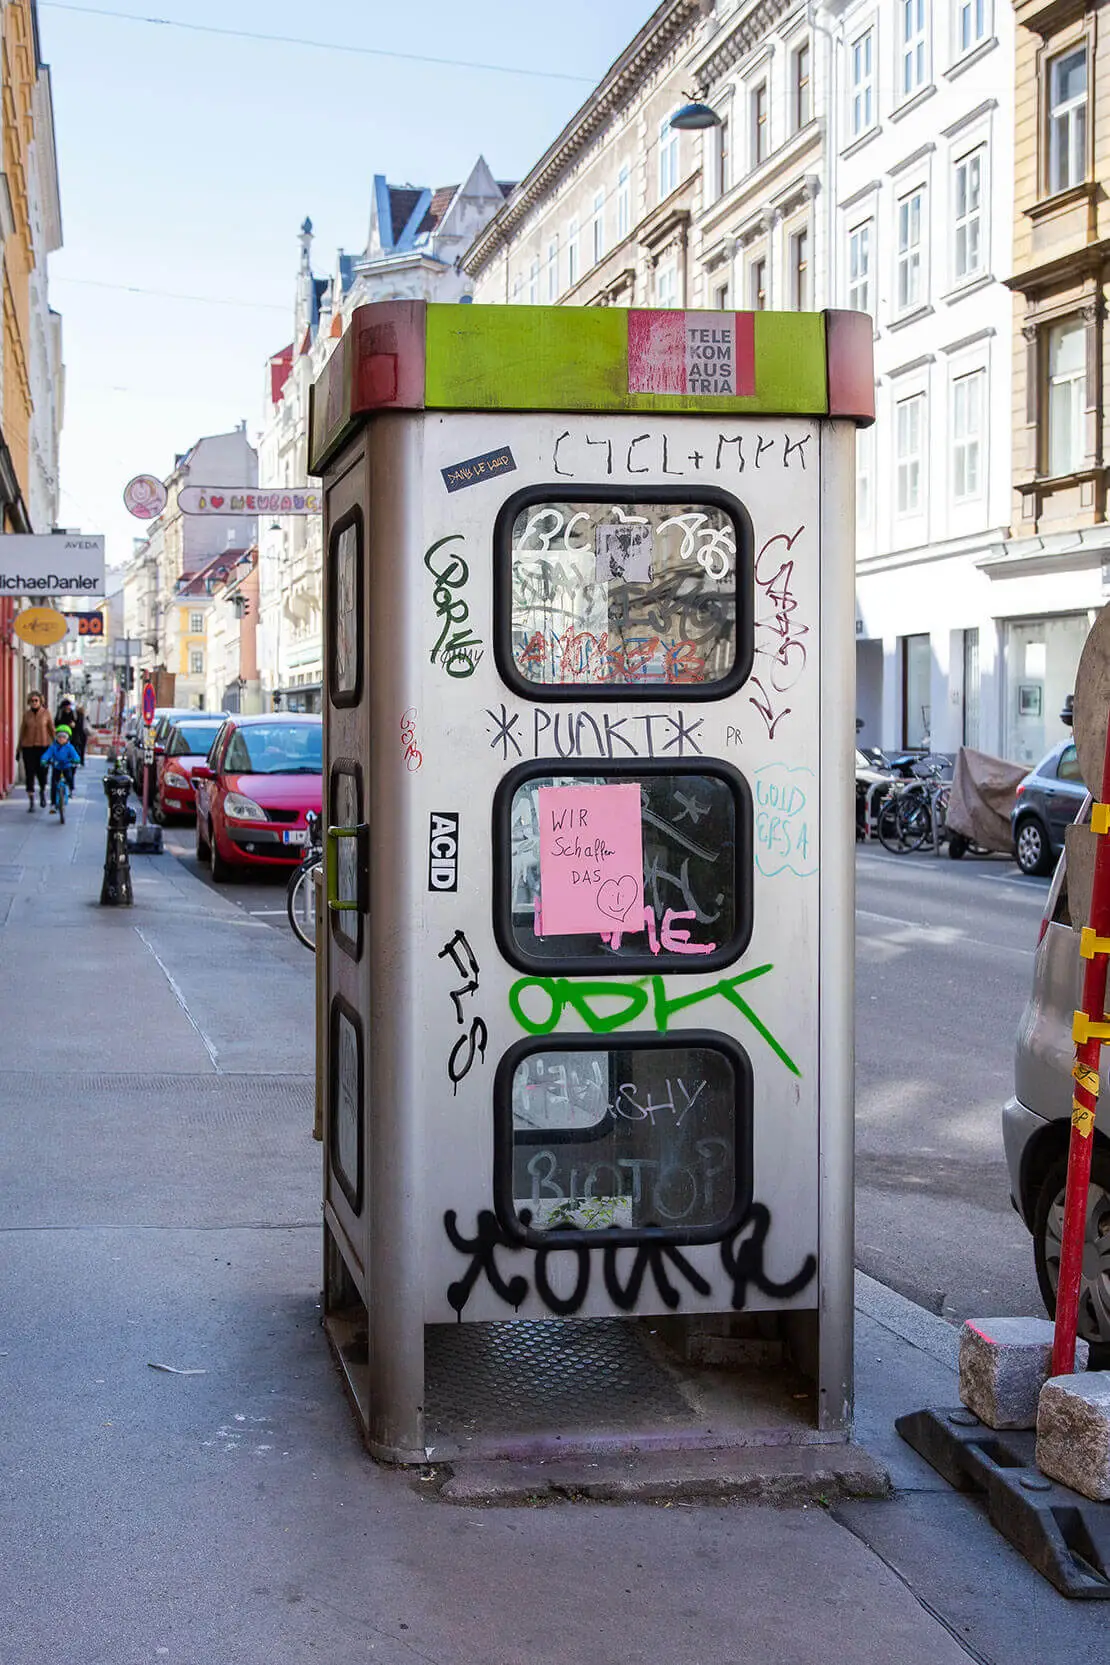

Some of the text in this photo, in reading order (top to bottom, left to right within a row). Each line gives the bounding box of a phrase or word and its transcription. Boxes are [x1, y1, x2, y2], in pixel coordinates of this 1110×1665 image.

[688, 329, 731, 343] TELE
[690, 345, 731, 360] KOM
[689, 363, 731, 378] AUS
[689, 379, 732, 393] TRIA
[65, 541, 99, 550] AVEDA
[726, 725, 743, 747] PR
[551, 808, 589, 832] WIR
[431, 814, 457, 889] ACID
[571, 869, 601, 885] DAS
